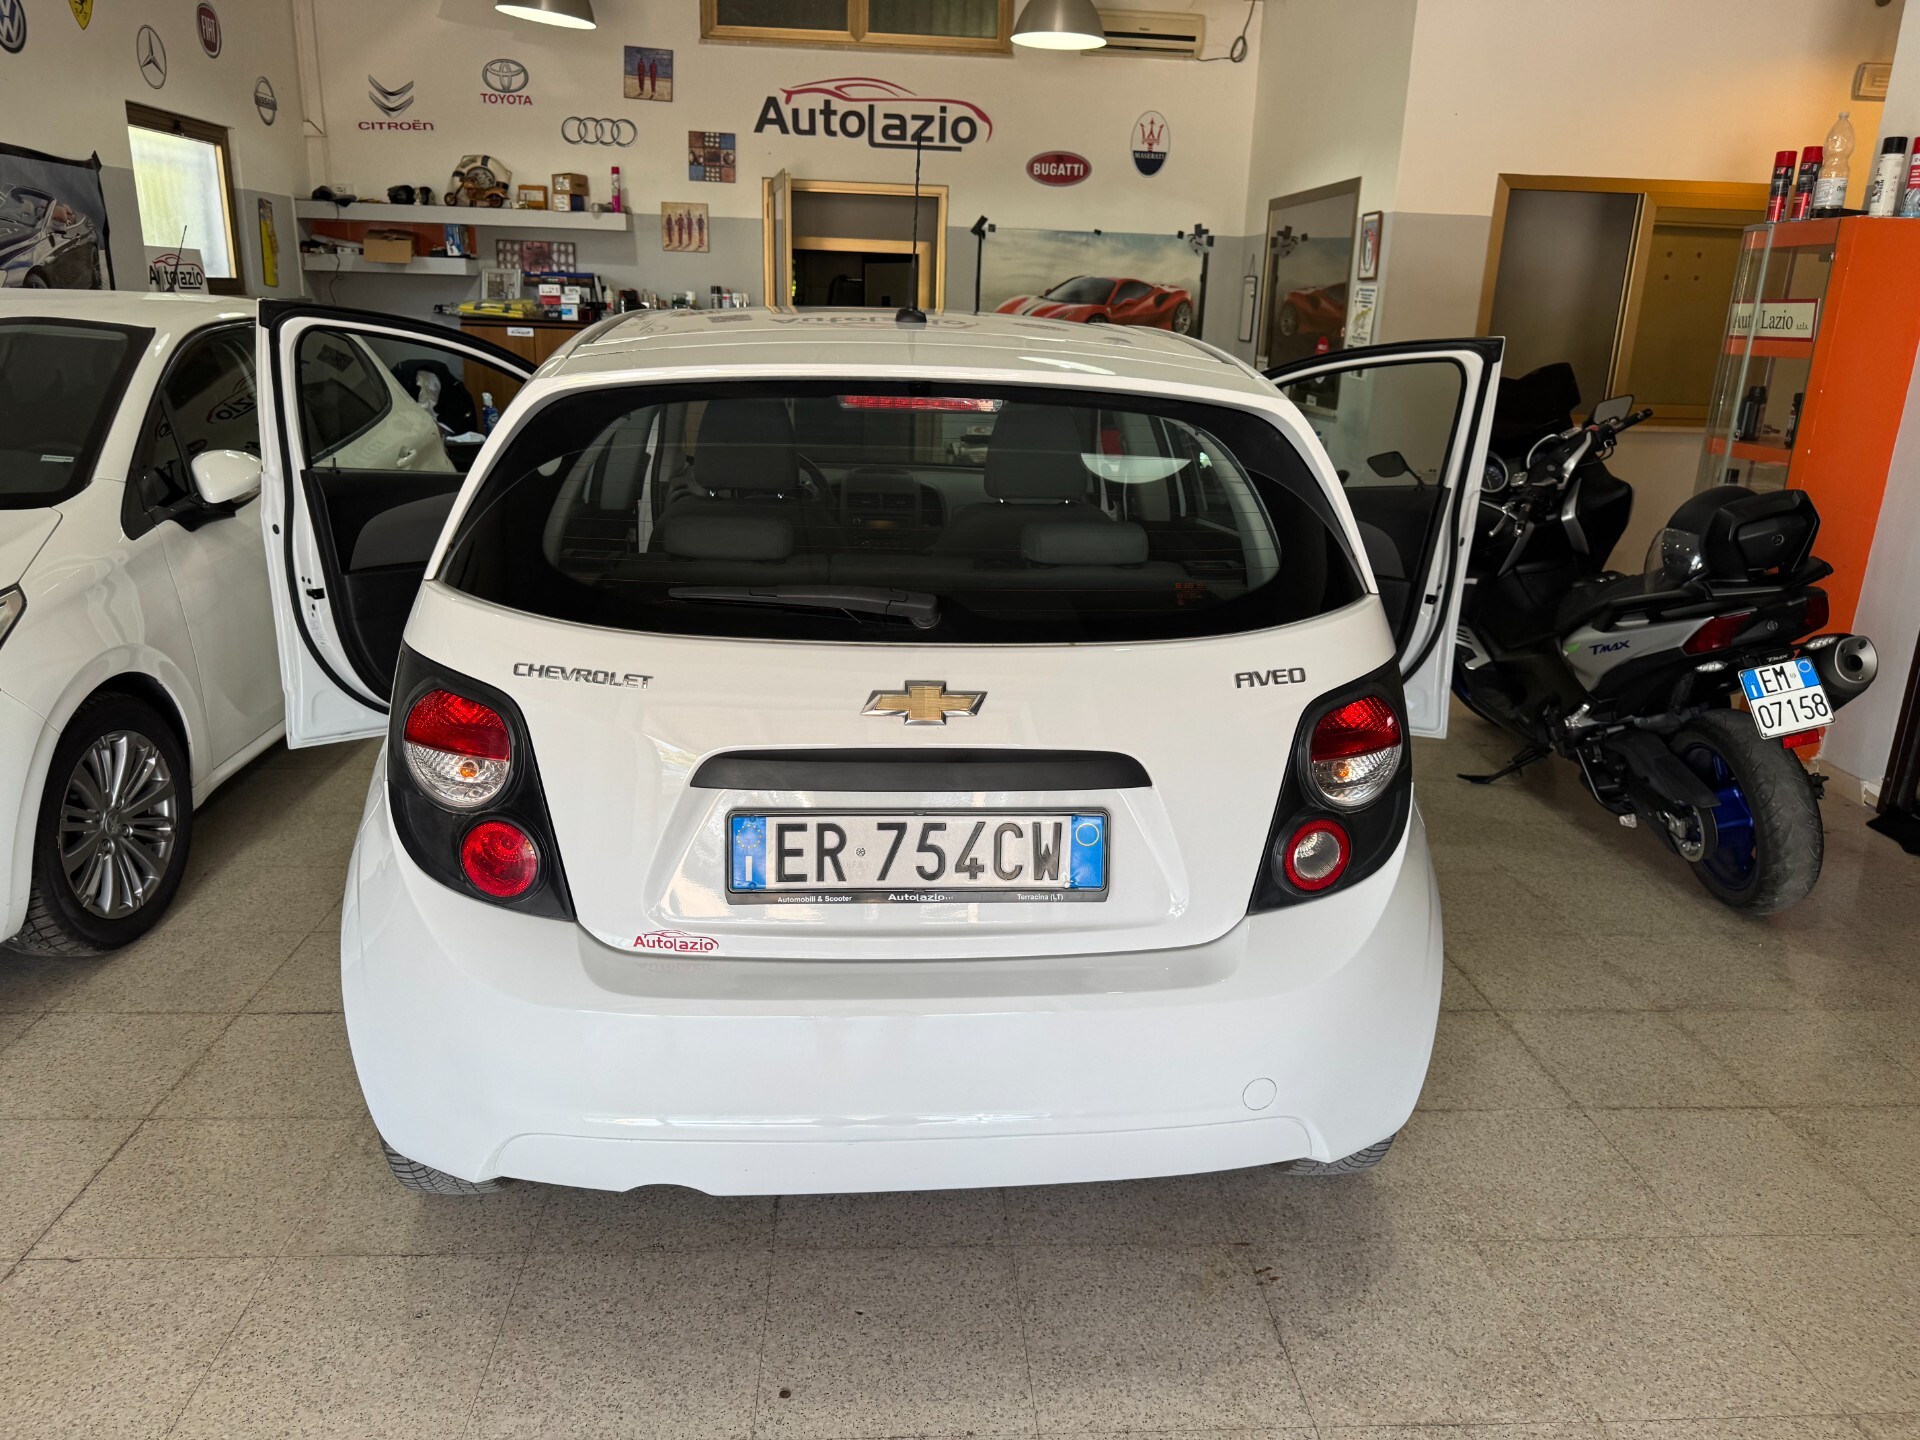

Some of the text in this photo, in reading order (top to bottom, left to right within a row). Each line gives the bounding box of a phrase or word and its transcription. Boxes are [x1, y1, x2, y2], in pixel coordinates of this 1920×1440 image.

[201, 15, 216, 43] FIAT
[480, 93, 533, 106] TOYOTA
[1033, 162, 1084, 177] BUGATTI
[1760, 309, 1793, 330] Lazio
[1588, 640, 1631, 655] TMAX
[513, 662, 654, 690] CHEVROLET
[1234, 667, 1306, 688] AVEO
[1758, 665, 1792, 694] EM
[1757, 693, 1829, 729] 07158
[776, 821, 1063, 883] ER 754CW
[824, 894, 852, 902] Scooter
[1017, 893, 1064, 902] Terracina (LT)
